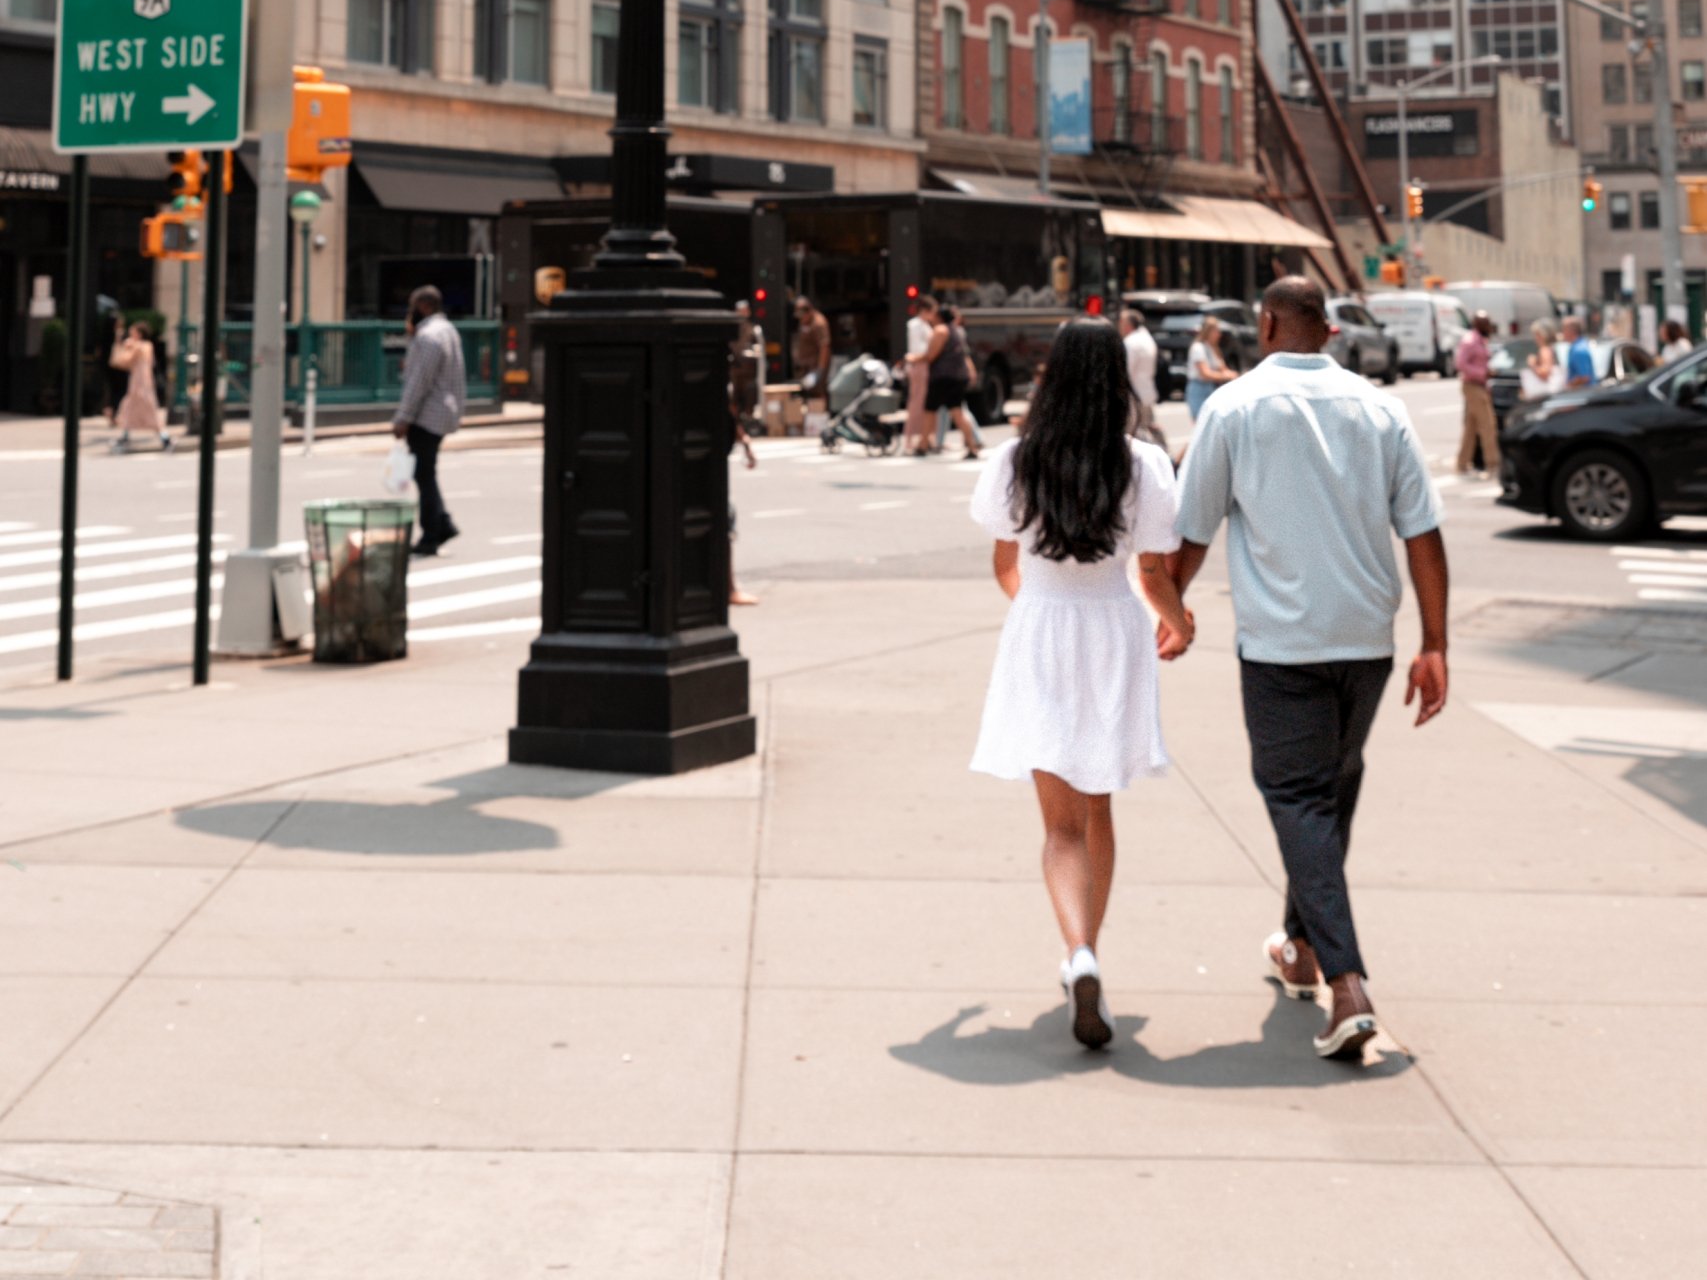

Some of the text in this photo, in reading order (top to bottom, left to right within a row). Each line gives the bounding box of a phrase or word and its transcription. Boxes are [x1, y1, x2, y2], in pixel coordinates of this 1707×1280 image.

[77, 33, 225, 72] WEST SIDE
[79, 91, 136, 125] HWY
